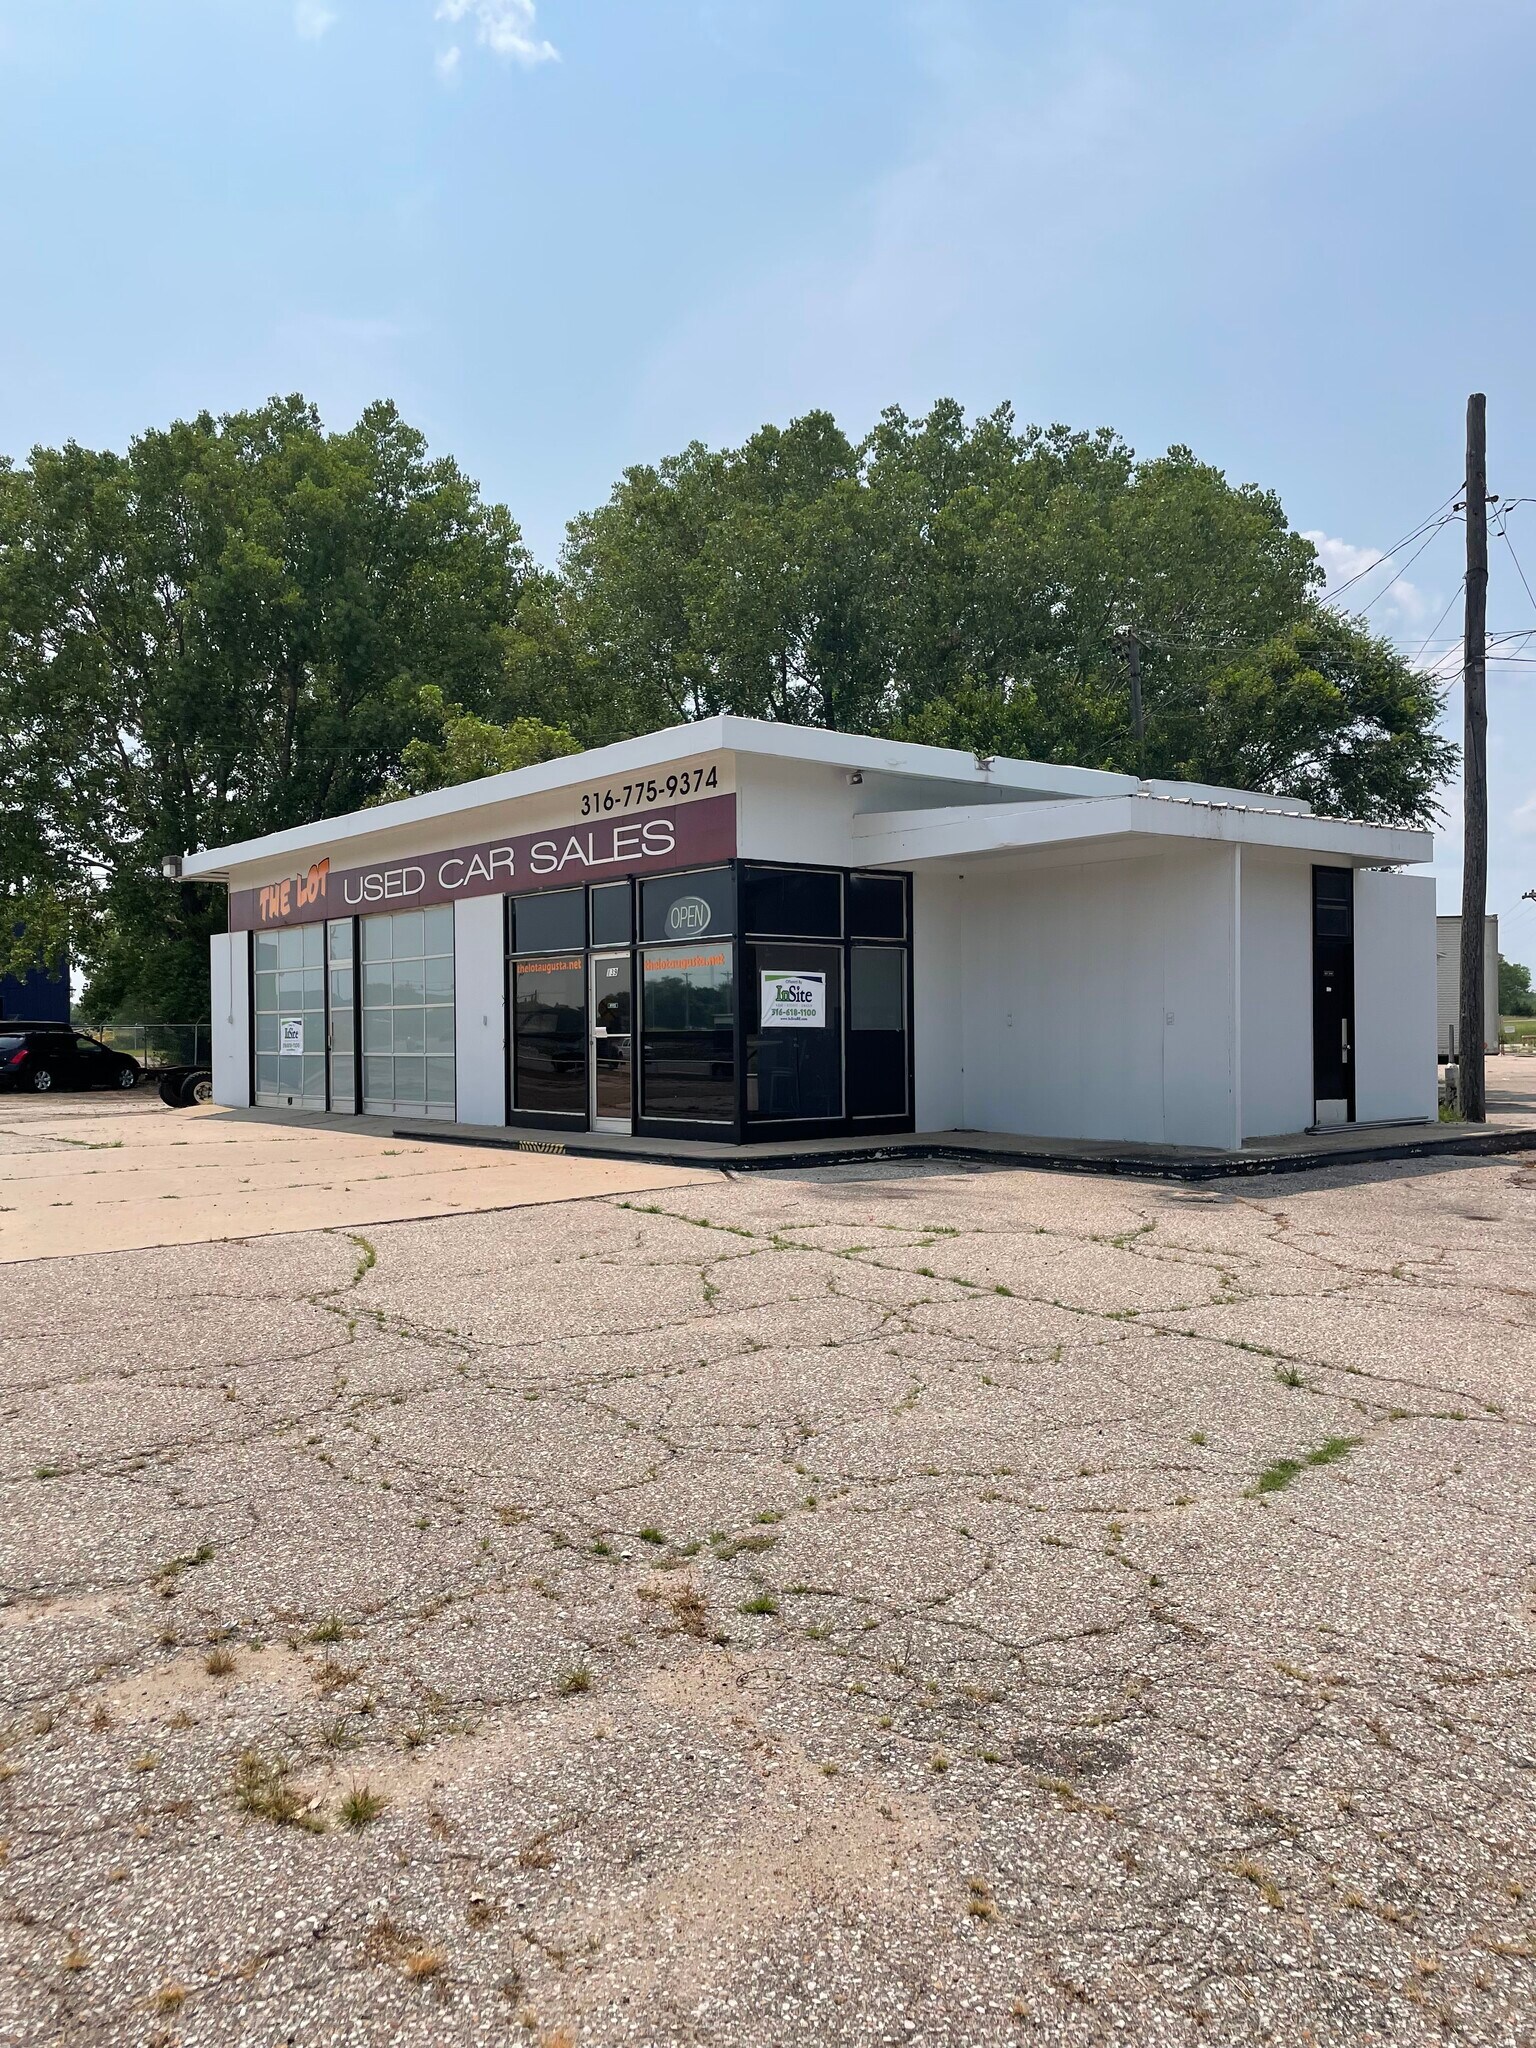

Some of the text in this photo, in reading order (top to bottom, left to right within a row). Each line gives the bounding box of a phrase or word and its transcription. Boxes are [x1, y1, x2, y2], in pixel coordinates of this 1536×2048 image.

[581, 765, 718, 816] 316-775-9374
[259, 819, 676, 922] THE LOT USED CAR SALES
[670, 904, 704, 929] OPEN
[517, 959, 582, 974] thelotaugusta.net
[775, 985, 812, 1002] InSite
[771, 1008, 816, 1016] 316-618-1100
